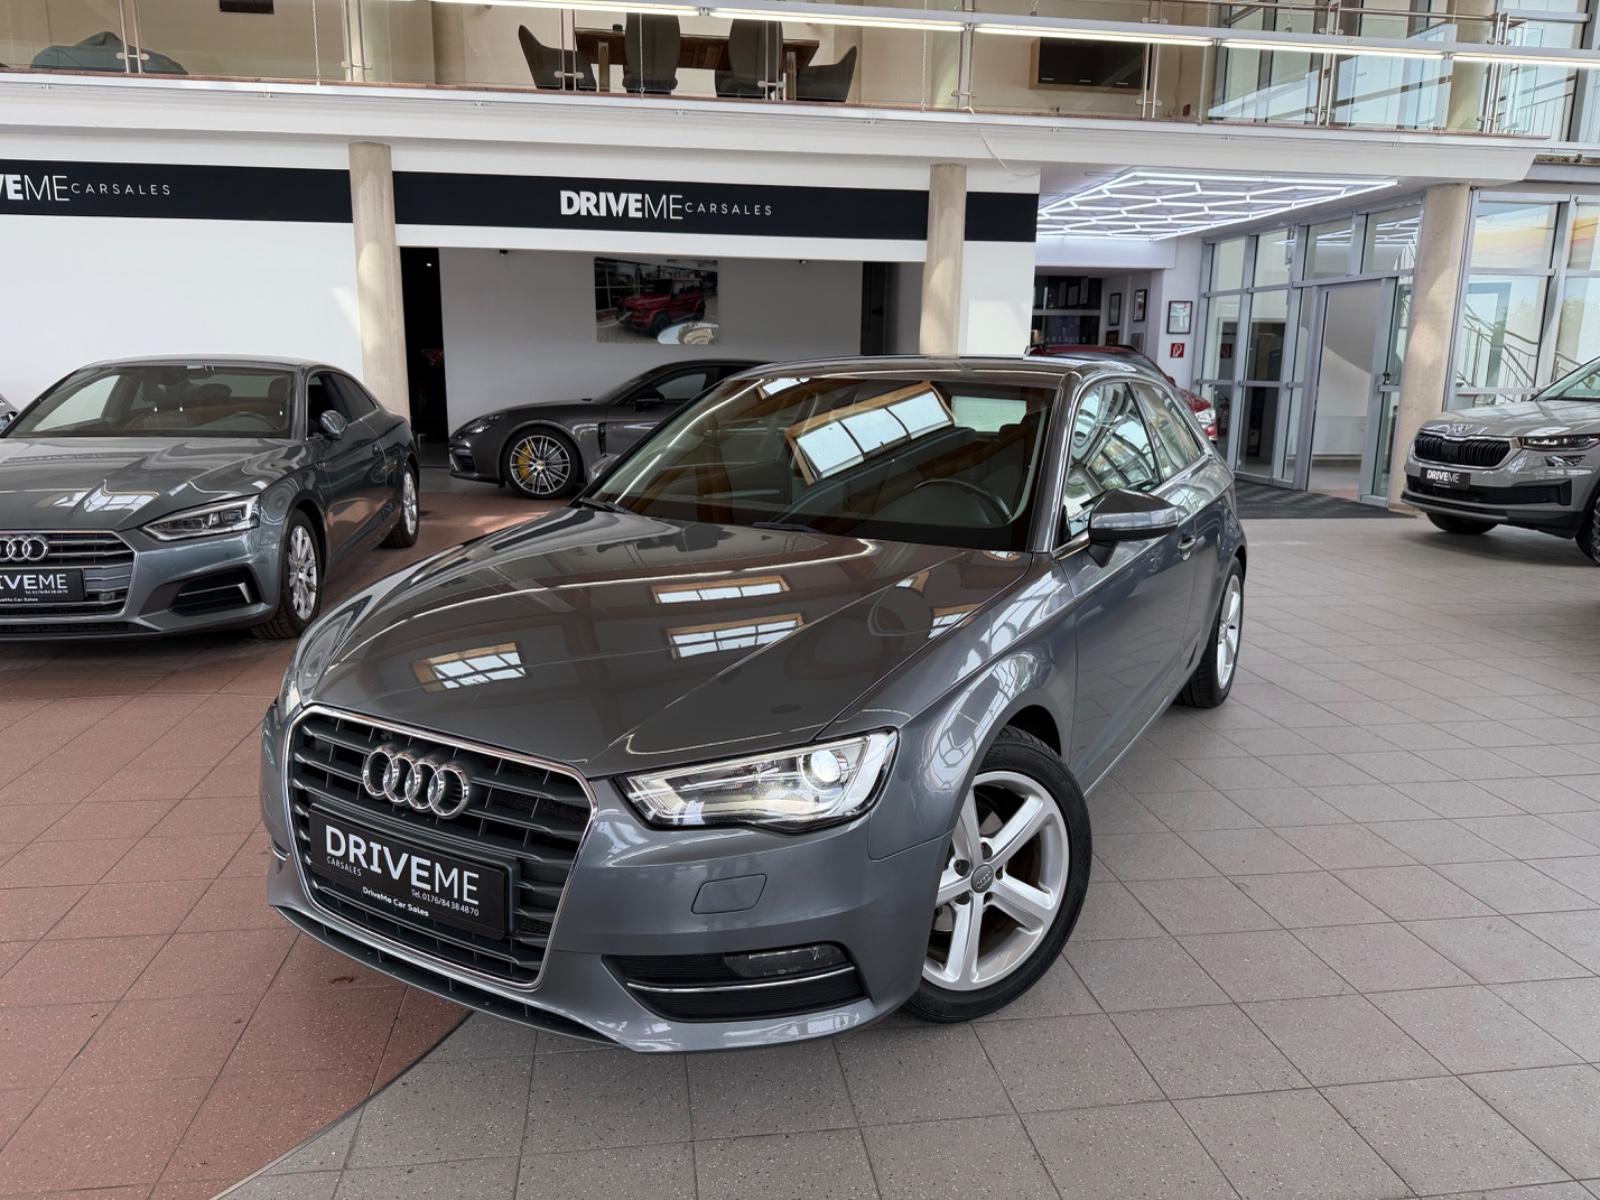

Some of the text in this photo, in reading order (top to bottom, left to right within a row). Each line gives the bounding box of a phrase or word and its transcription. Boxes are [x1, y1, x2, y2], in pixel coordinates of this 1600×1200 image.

[0, 174, 170, 201] EME CARSALES
[560, 190, 772, 219] DRIVEME CARSALES
[325, 825, 479, 905] DRIVEME
[327, 855, 362, 877] CARSALES
[393, 898, 406, 909] Car
[407, 903, 429, 917] Sales
